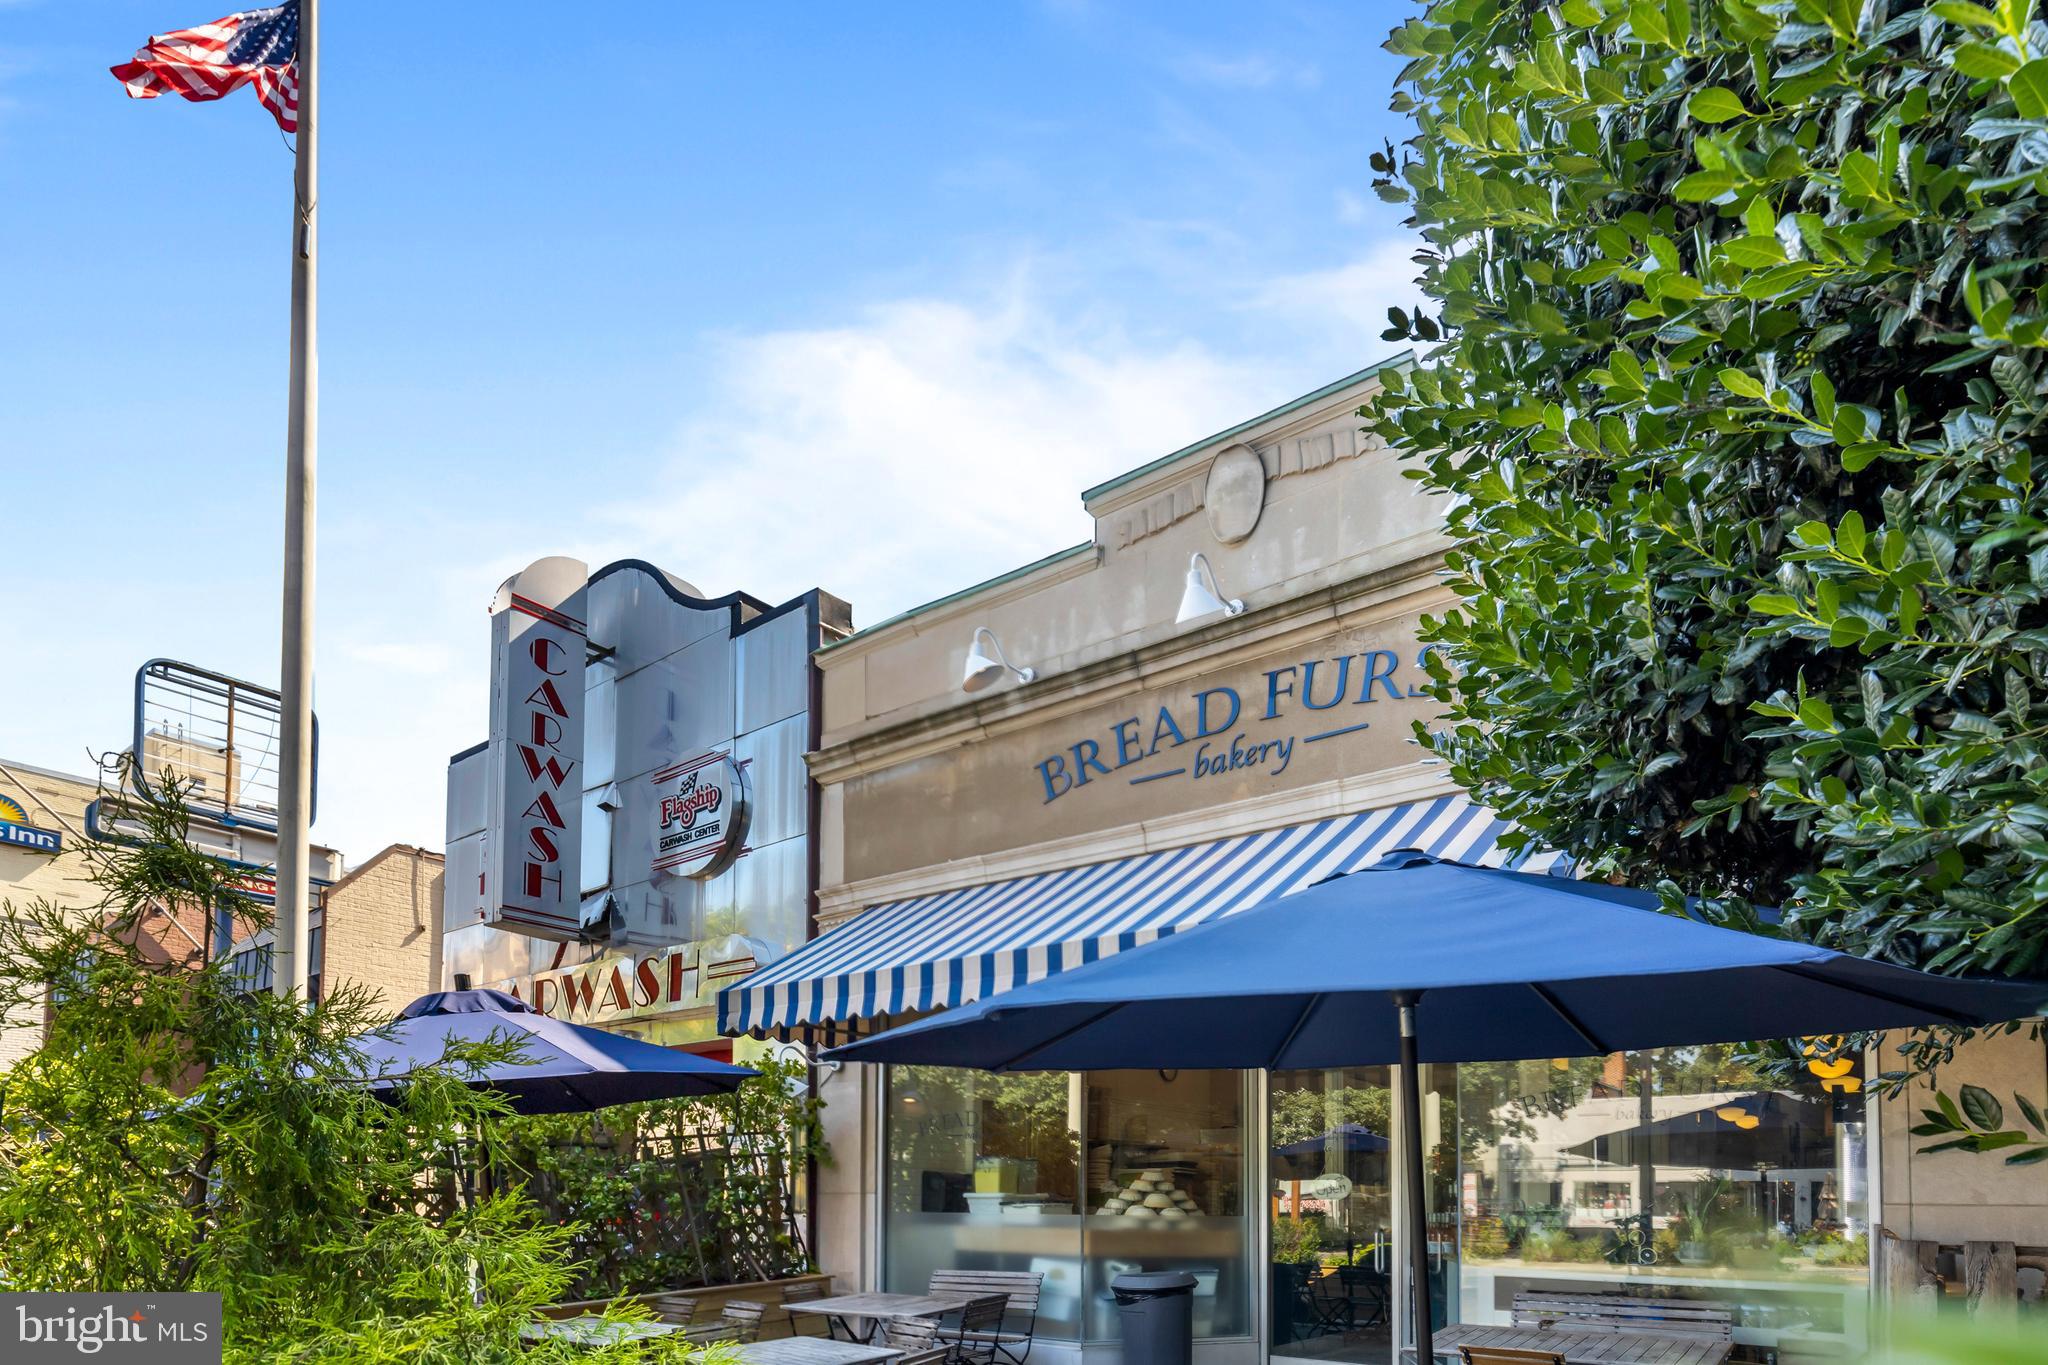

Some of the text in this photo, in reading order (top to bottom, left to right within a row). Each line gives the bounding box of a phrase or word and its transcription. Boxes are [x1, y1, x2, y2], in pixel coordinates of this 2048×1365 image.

[1034, 686, 1241, 805] BREAD
[1193, 732, 1294, 779] bakery
[516, 638, 574, 902] CARWASH
[660, 784, 722, 829] Flagship
[9, 825, 54, 848] Inn
[660, 823, 720, 849] CARWASH CENTER
